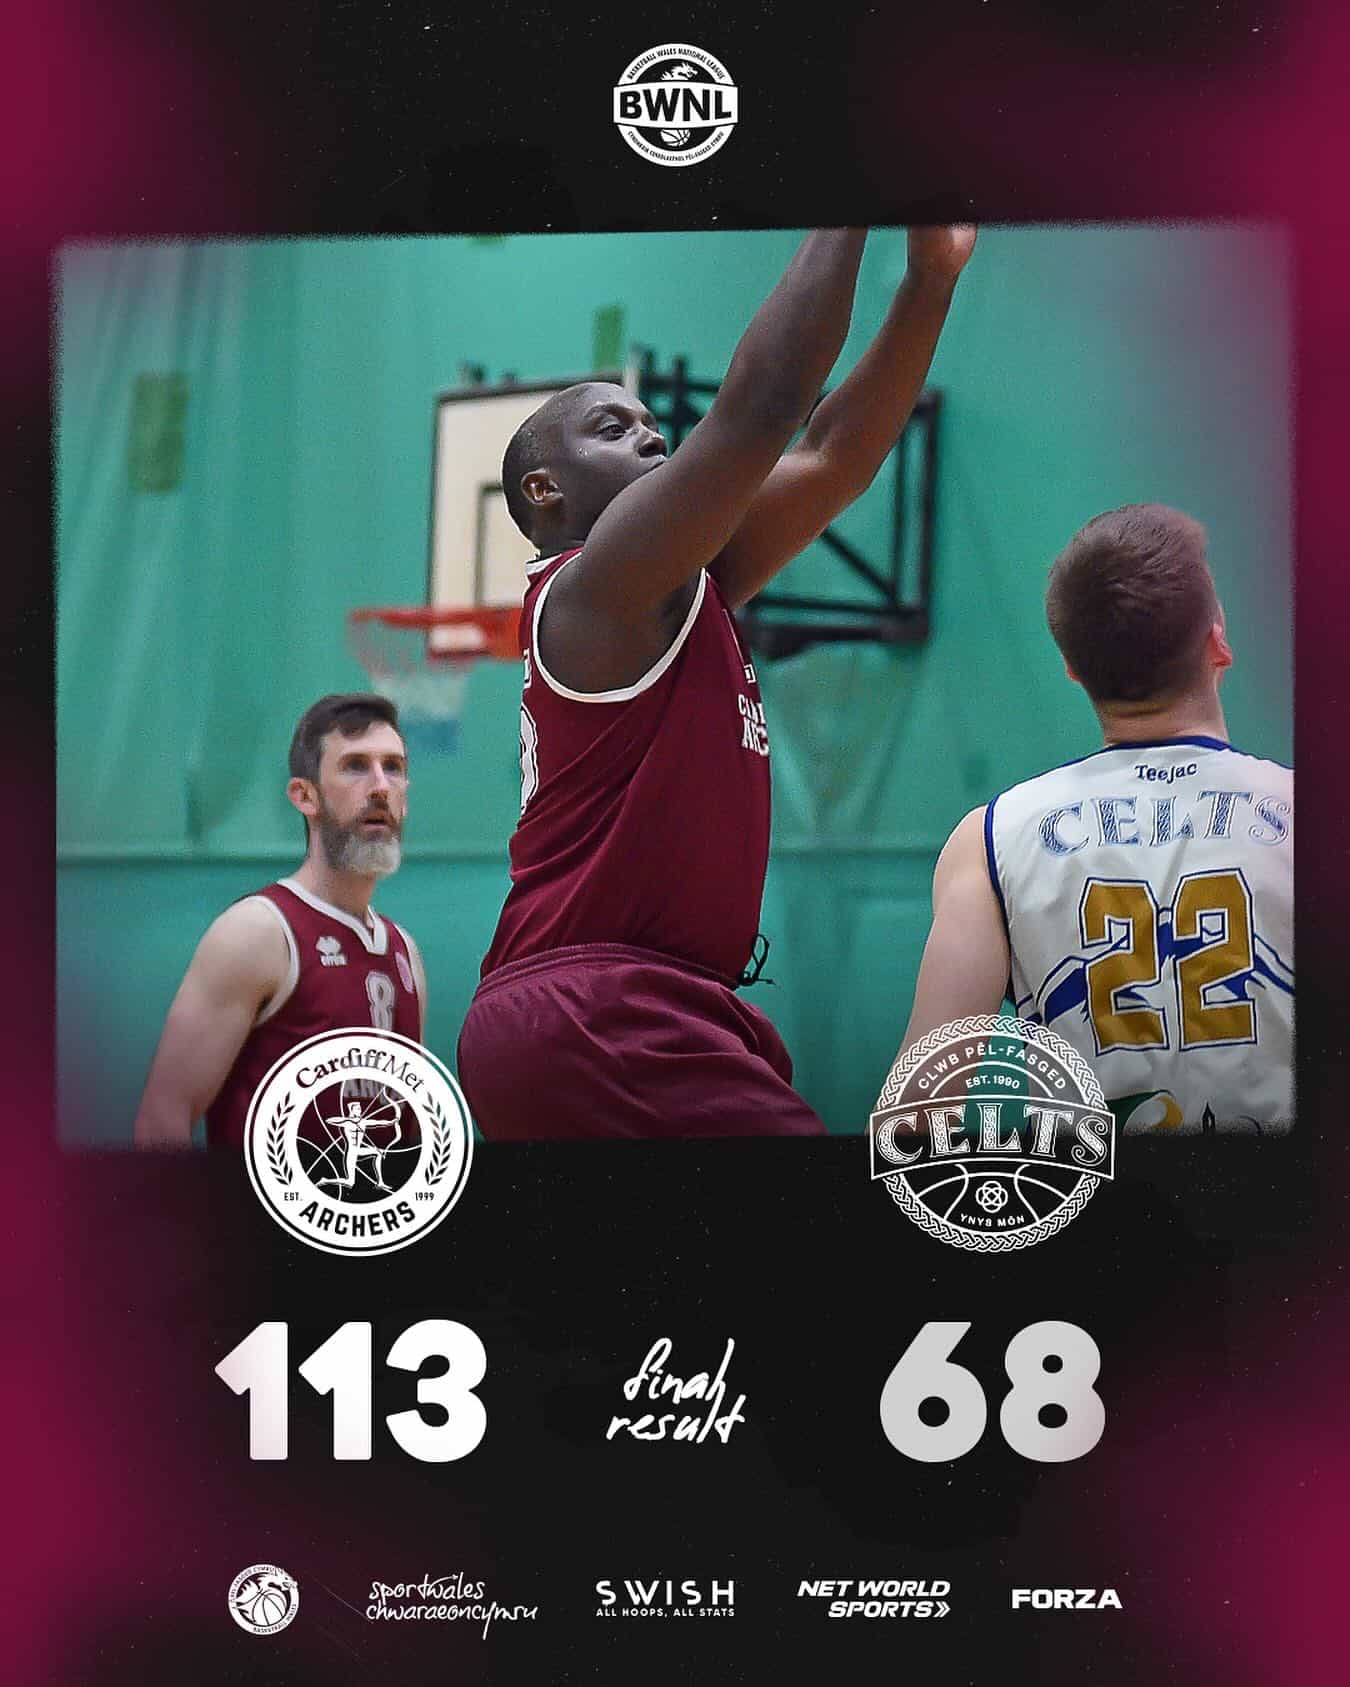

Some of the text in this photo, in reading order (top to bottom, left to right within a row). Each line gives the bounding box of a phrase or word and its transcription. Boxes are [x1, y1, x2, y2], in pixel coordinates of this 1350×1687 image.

[1134, 762, 1197, 784] Teejac
[1038, 790, 1291, 857] CELTS
[1078, 867, 1257, 1057] 22
